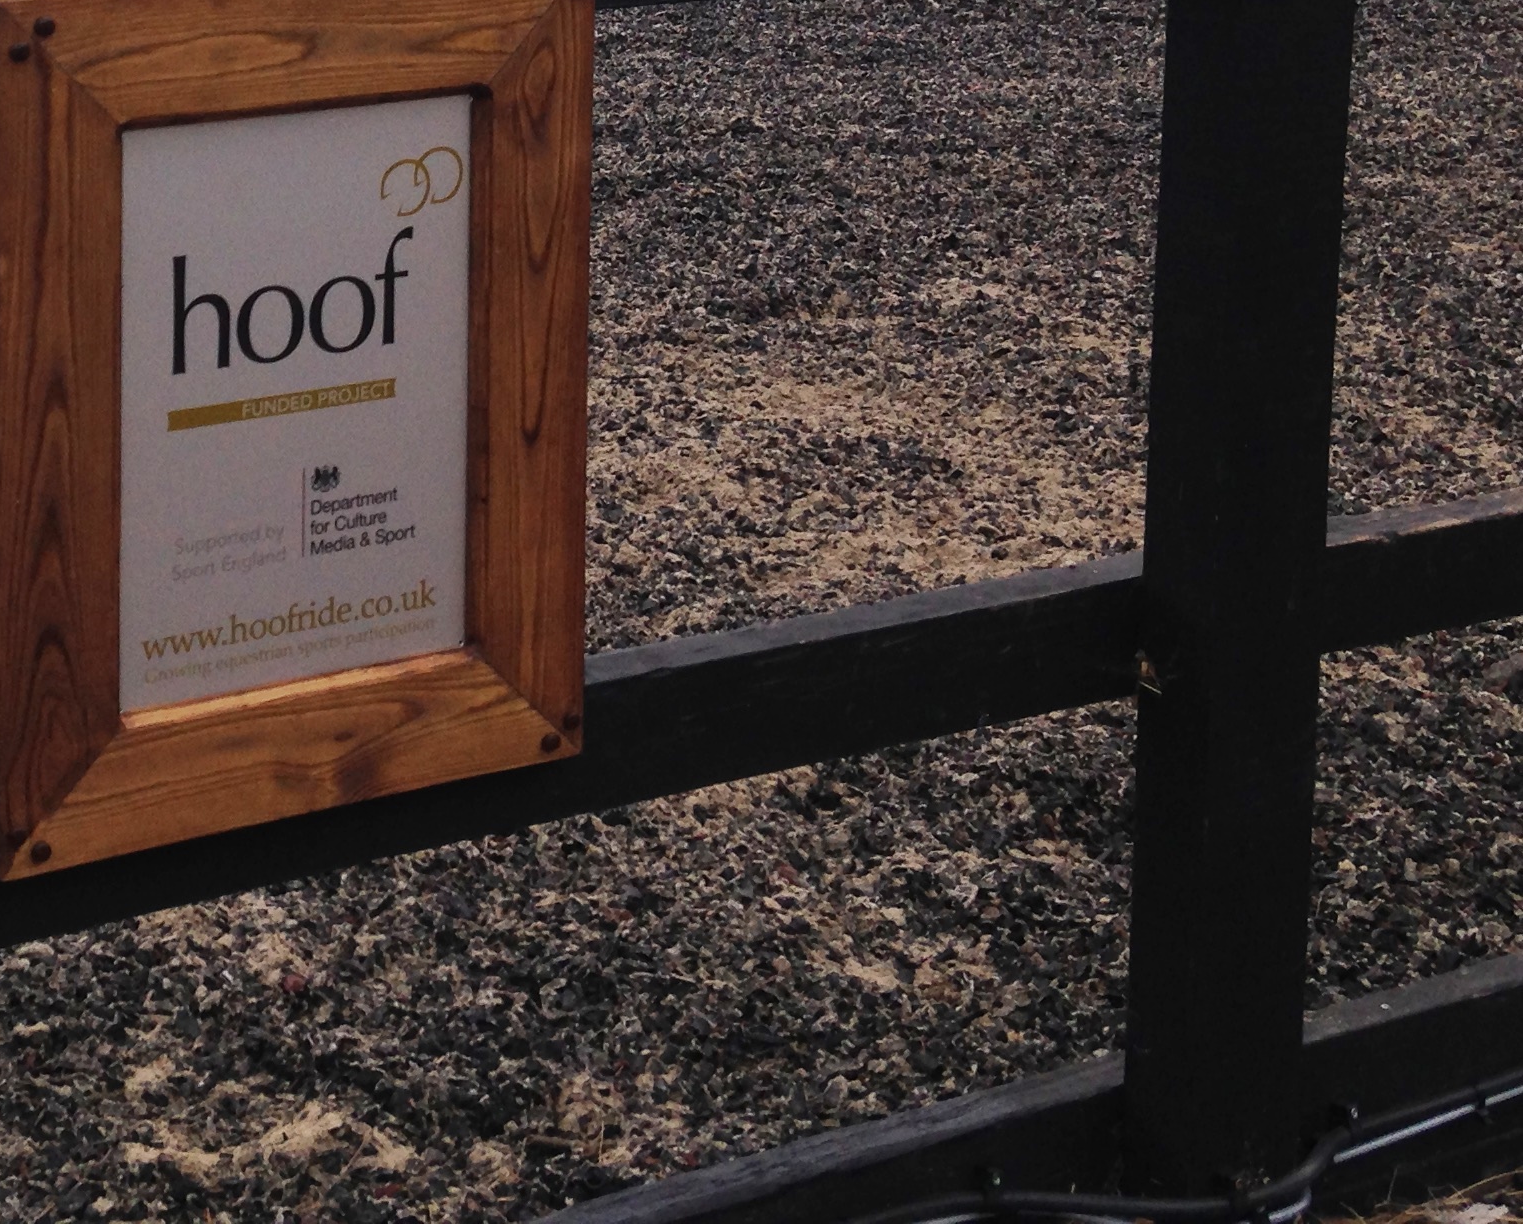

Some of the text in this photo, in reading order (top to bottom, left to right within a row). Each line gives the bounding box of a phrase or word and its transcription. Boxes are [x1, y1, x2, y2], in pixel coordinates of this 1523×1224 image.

[171, 226, 414, 376] hoof
[241, 381, 392, 419] FUNDED PROJECT
[310, 487, 398, 516] Department
[309, 509, 388, 536] for Culture
[309, 524, 417, 557] Media & Sport
[141, 578, 437, 661] www.hoofride.co.uk
